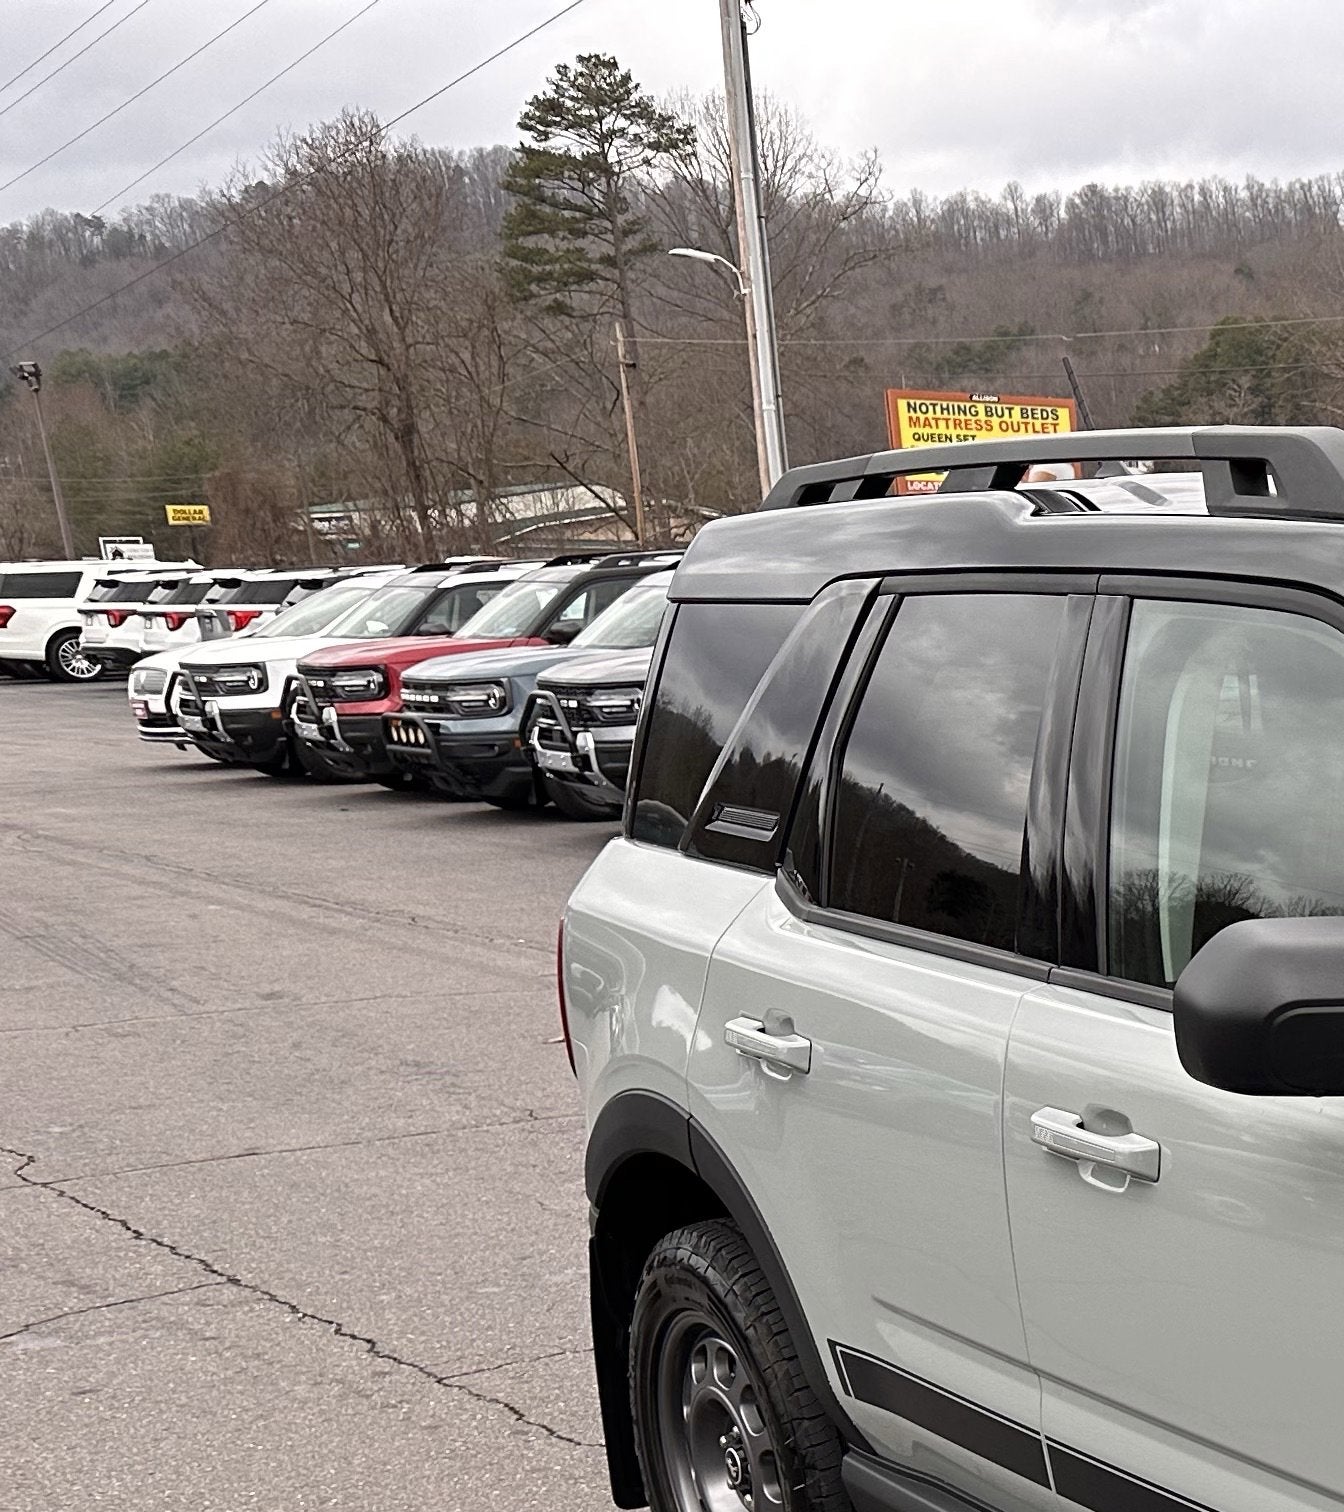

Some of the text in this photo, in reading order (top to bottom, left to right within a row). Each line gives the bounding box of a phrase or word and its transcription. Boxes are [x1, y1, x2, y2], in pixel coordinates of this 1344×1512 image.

[907, 401, 1060, 421] NOTHING BUT BEDS
[908, 416, 1059, 434] MATTRESS OUTLET
[912, 432, 953, 443] QUEEN
[907, 481, 942, 491] LOCAT
